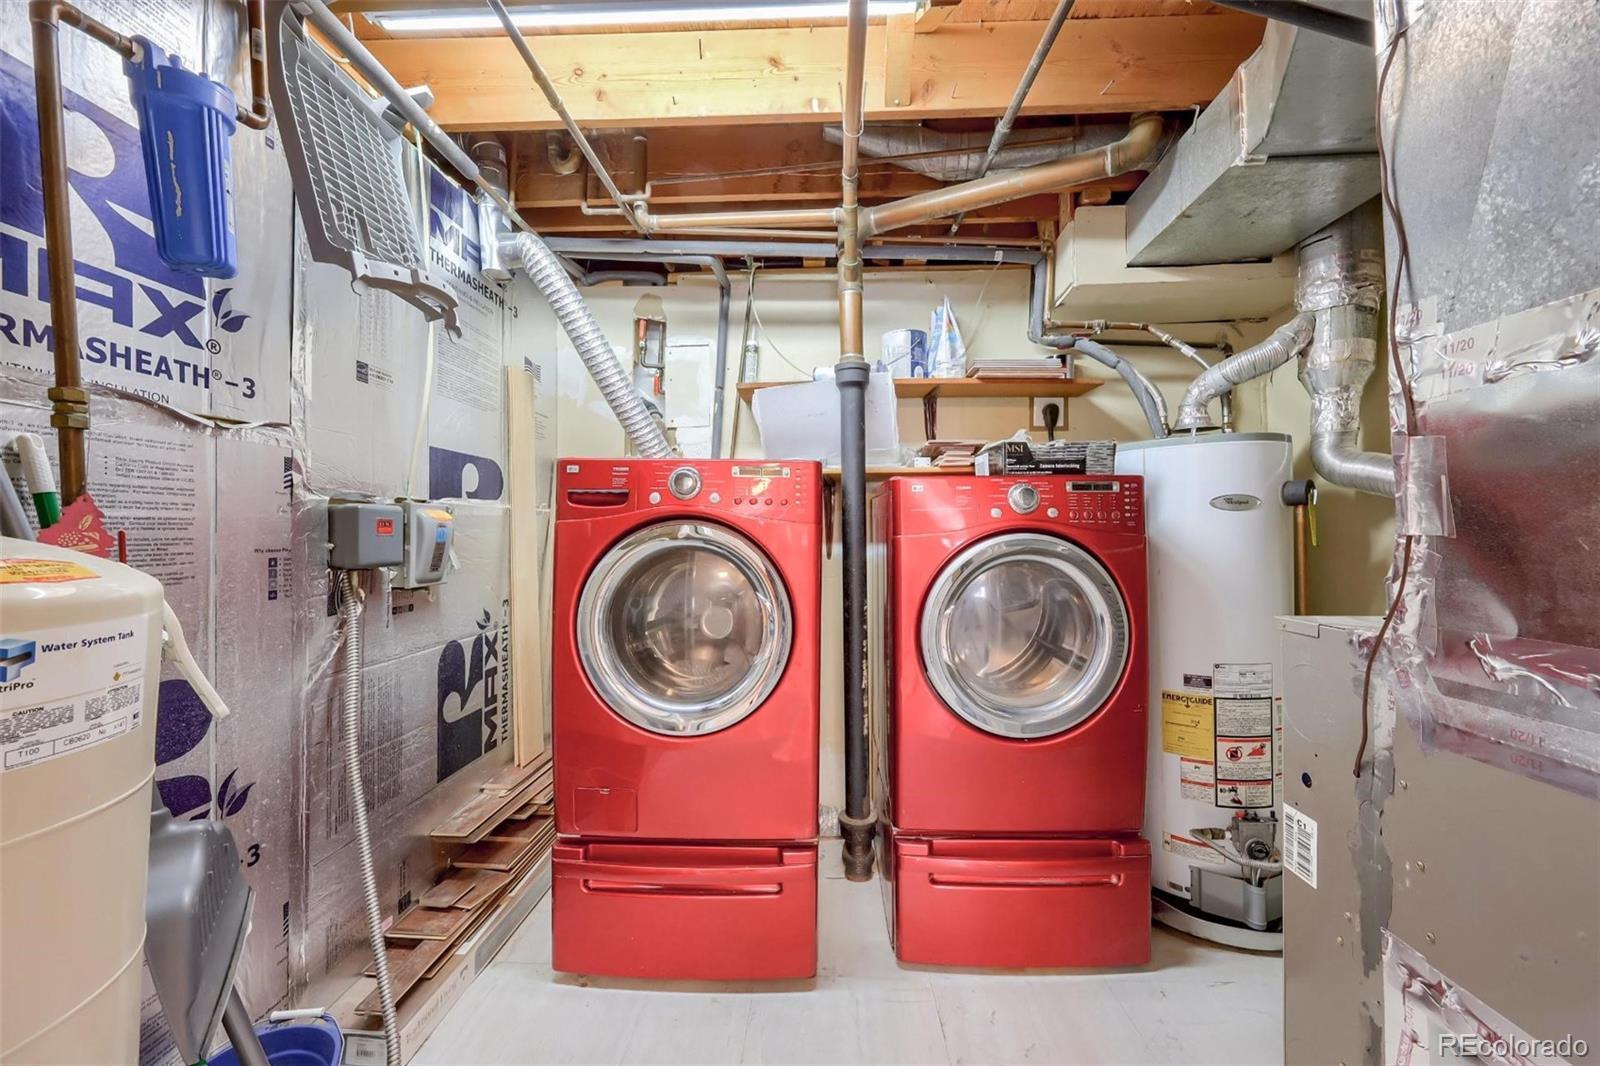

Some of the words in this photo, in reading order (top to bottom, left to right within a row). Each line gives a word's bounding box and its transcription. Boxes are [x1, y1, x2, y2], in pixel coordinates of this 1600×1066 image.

[1442, 337, 1475, 356] 11/20
[41, 641, 78, 653] Water
[81, 636, 116, 648] System
[118, 630, 135, 641] Tank
[12, 706, 44, 717] CAUTION
[18, 747, 40, 758] T100
